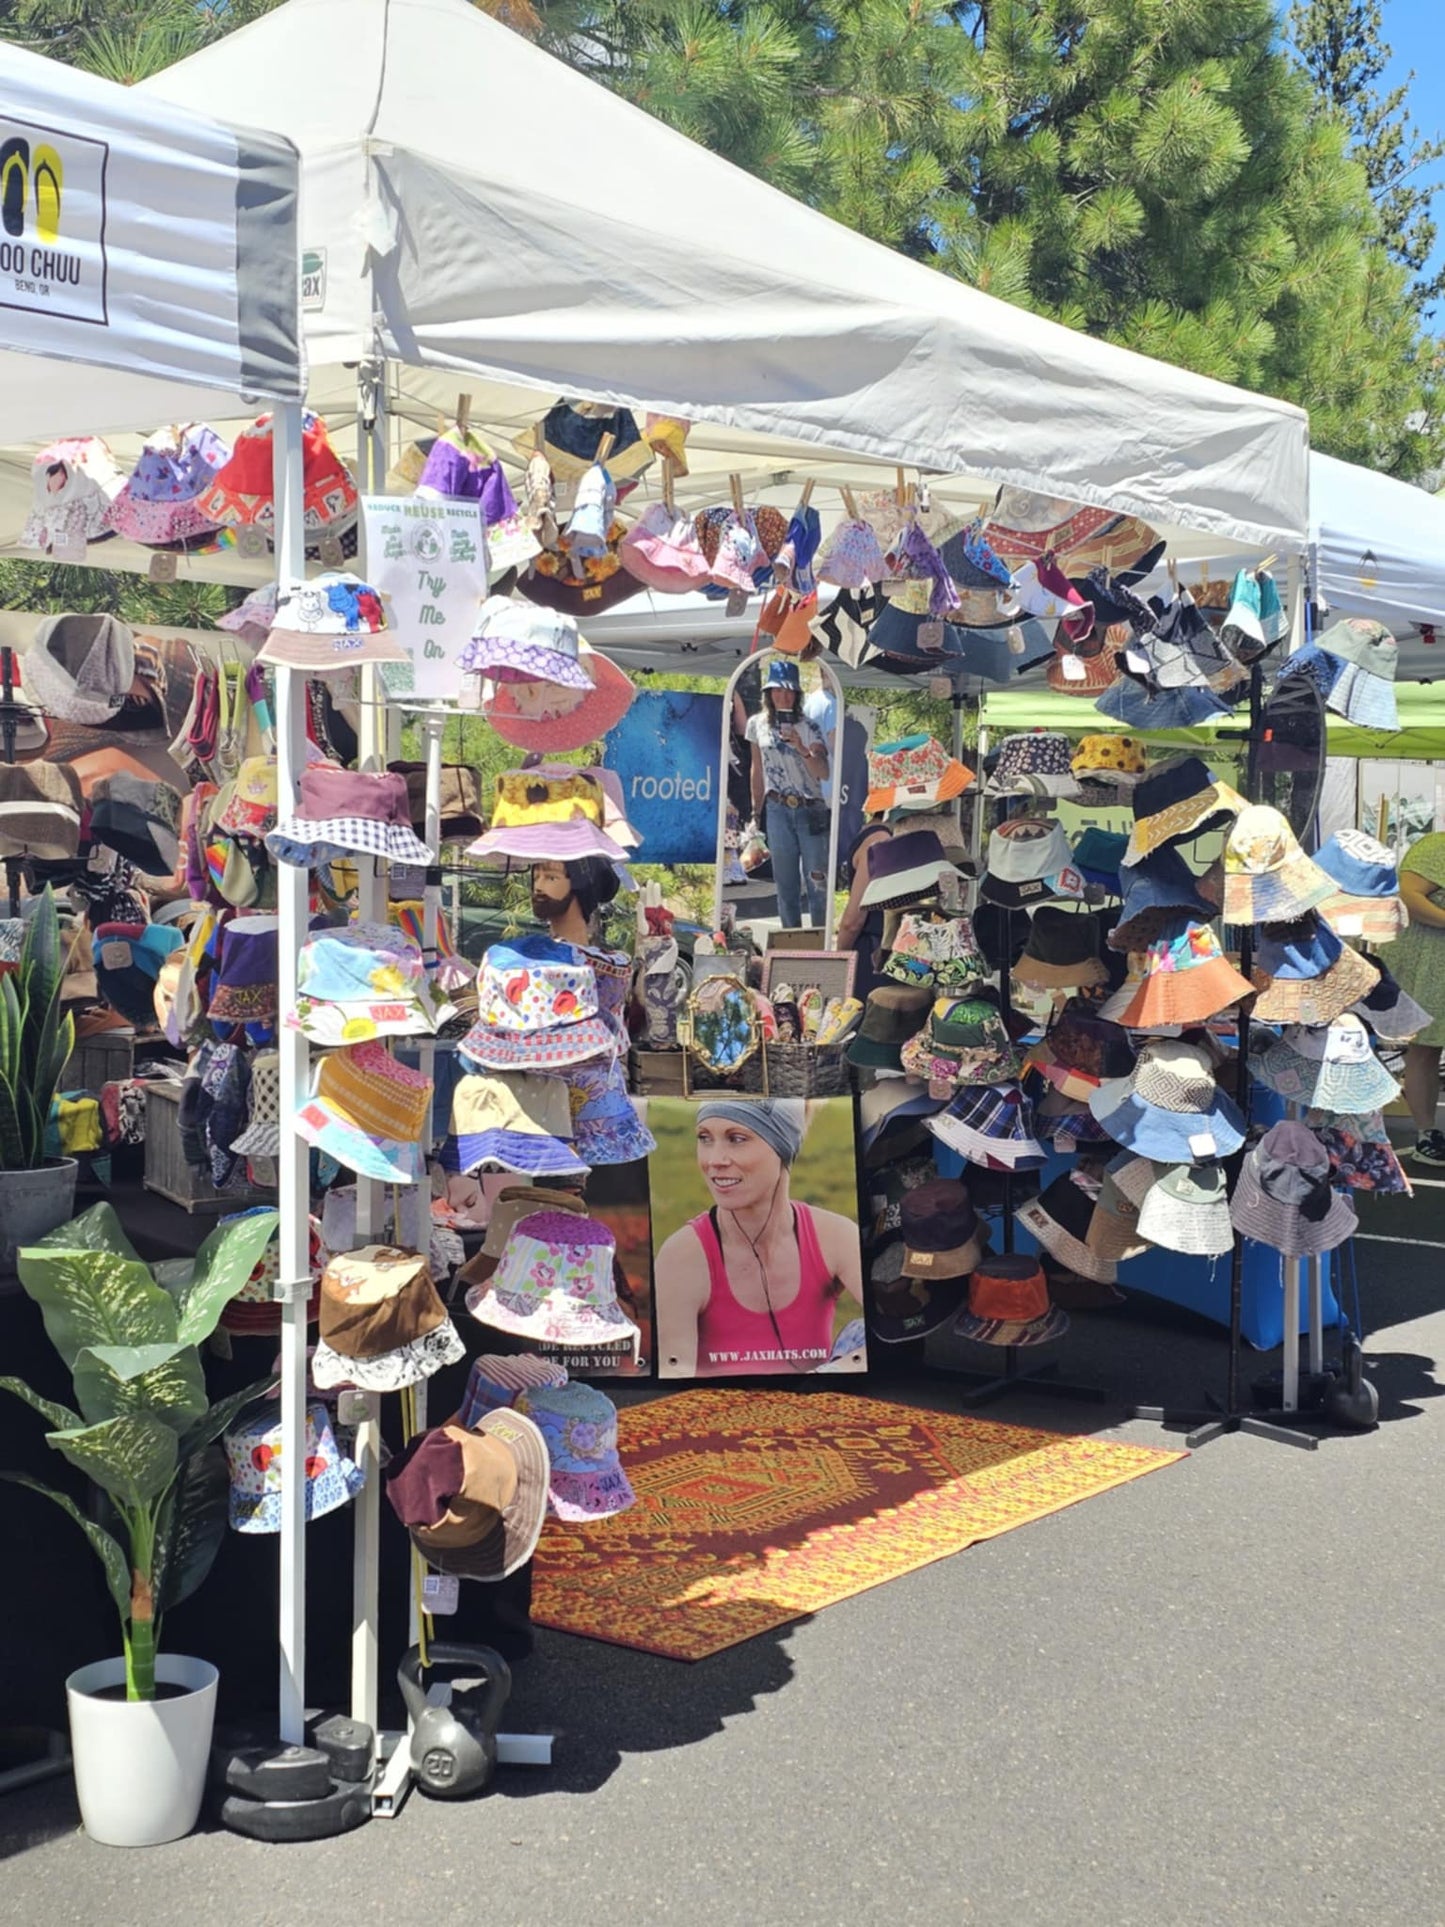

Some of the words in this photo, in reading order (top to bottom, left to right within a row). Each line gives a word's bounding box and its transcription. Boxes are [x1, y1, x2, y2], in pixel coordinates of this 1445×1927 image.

[31, 248, 81, 285] CHUU
[367, 503, 400, 513] REDUCE
[403, 504, 444, 519] REUSE
[446, 508, 477, 518] RECYCLE
[418, 570, 446, 598] Try
[419, 604, 446, 625] Me
[424, 639, 445, 659] On
[631, 766, 711, 801] rooted
[234, 989, 263, 1004] JAX
[563, 1356, 590, 1367] FOR
[592, 1356, 621, 1367] YOU
[709, 1348, 827, 1363] WWW.JAXHATS.COM
